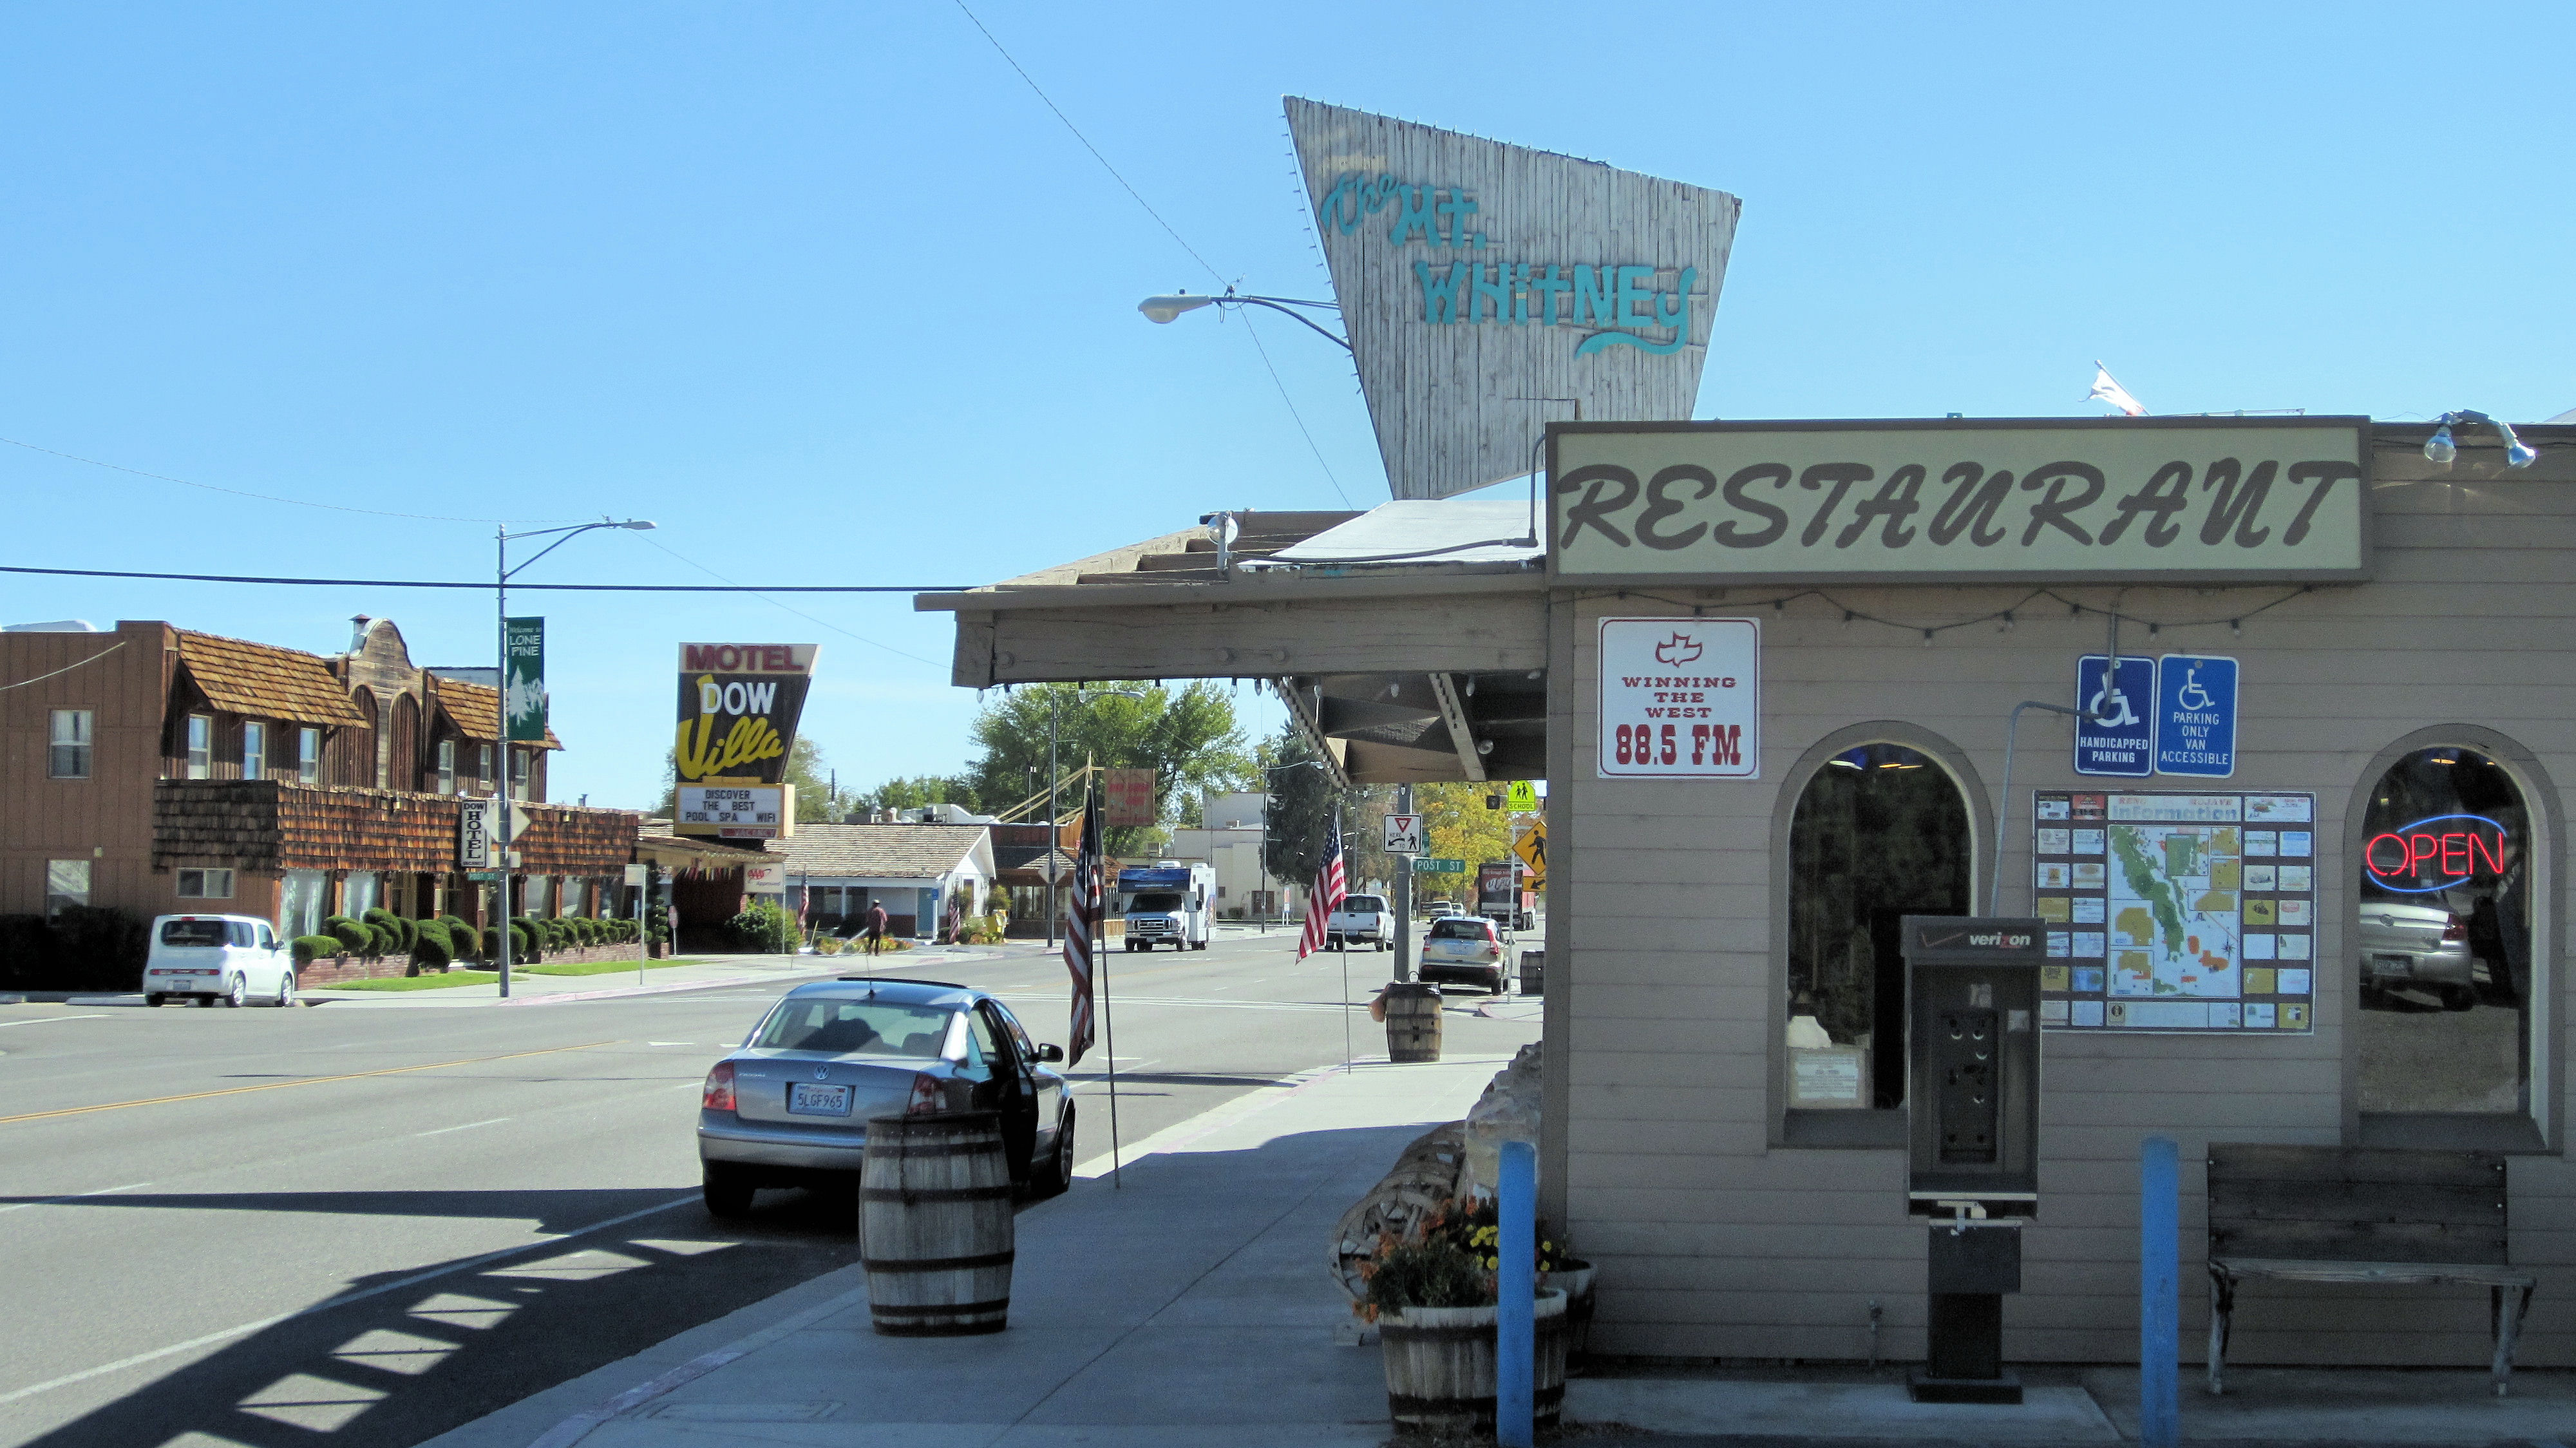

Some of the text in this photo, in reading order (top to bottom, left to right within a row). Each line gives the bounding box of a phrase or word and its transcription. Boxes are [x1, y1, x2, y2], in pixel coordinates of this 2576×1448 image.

[1320, 173, 1487, 250] The Mt.
[1556, 457, 2361, 550] RESTAURANT
[509, 634, 542, 645] LONE
[511, 645, 539, 656] PINE
[685, 644, 804, 671] MOTEL
[1622, 677, 1737, 688] WINNING
[702, 681, 777, 716] DOW
[1654, 692, 1705, 703] THE
[1645, 707, 1712, 718] WEST
[2174, 712, 2220, 725] PARKING
[676, 673, 784, 780] Villa
[2182, 725, 2210, 738] ONLY
[1616, 724, 1741, 765] 88.5 FM
[2080, 736, 2149, 750] HANDICAPPED
[2186, 739, 2206, 750] VAN
[2092, 750, 2136, 763] PARKING
[2161, 750, 2228, 765] ACCESSIBLE
[705, 790, 750, 799] DISCOVER
[703, 801, 755, 811] THE BEST
[685, 812, 775, 823] POOL SPA WIFI
[2112, 805, 2237, 821] information
[467, 811, 481, 859] HOTEL
[2365, 832, 2505, 877] OPEN
[1417, 861, 1441, 870] POST
[1969, 932, 2031, 948] verizon
[797, 1092, 842, 1109] 5LGF965
